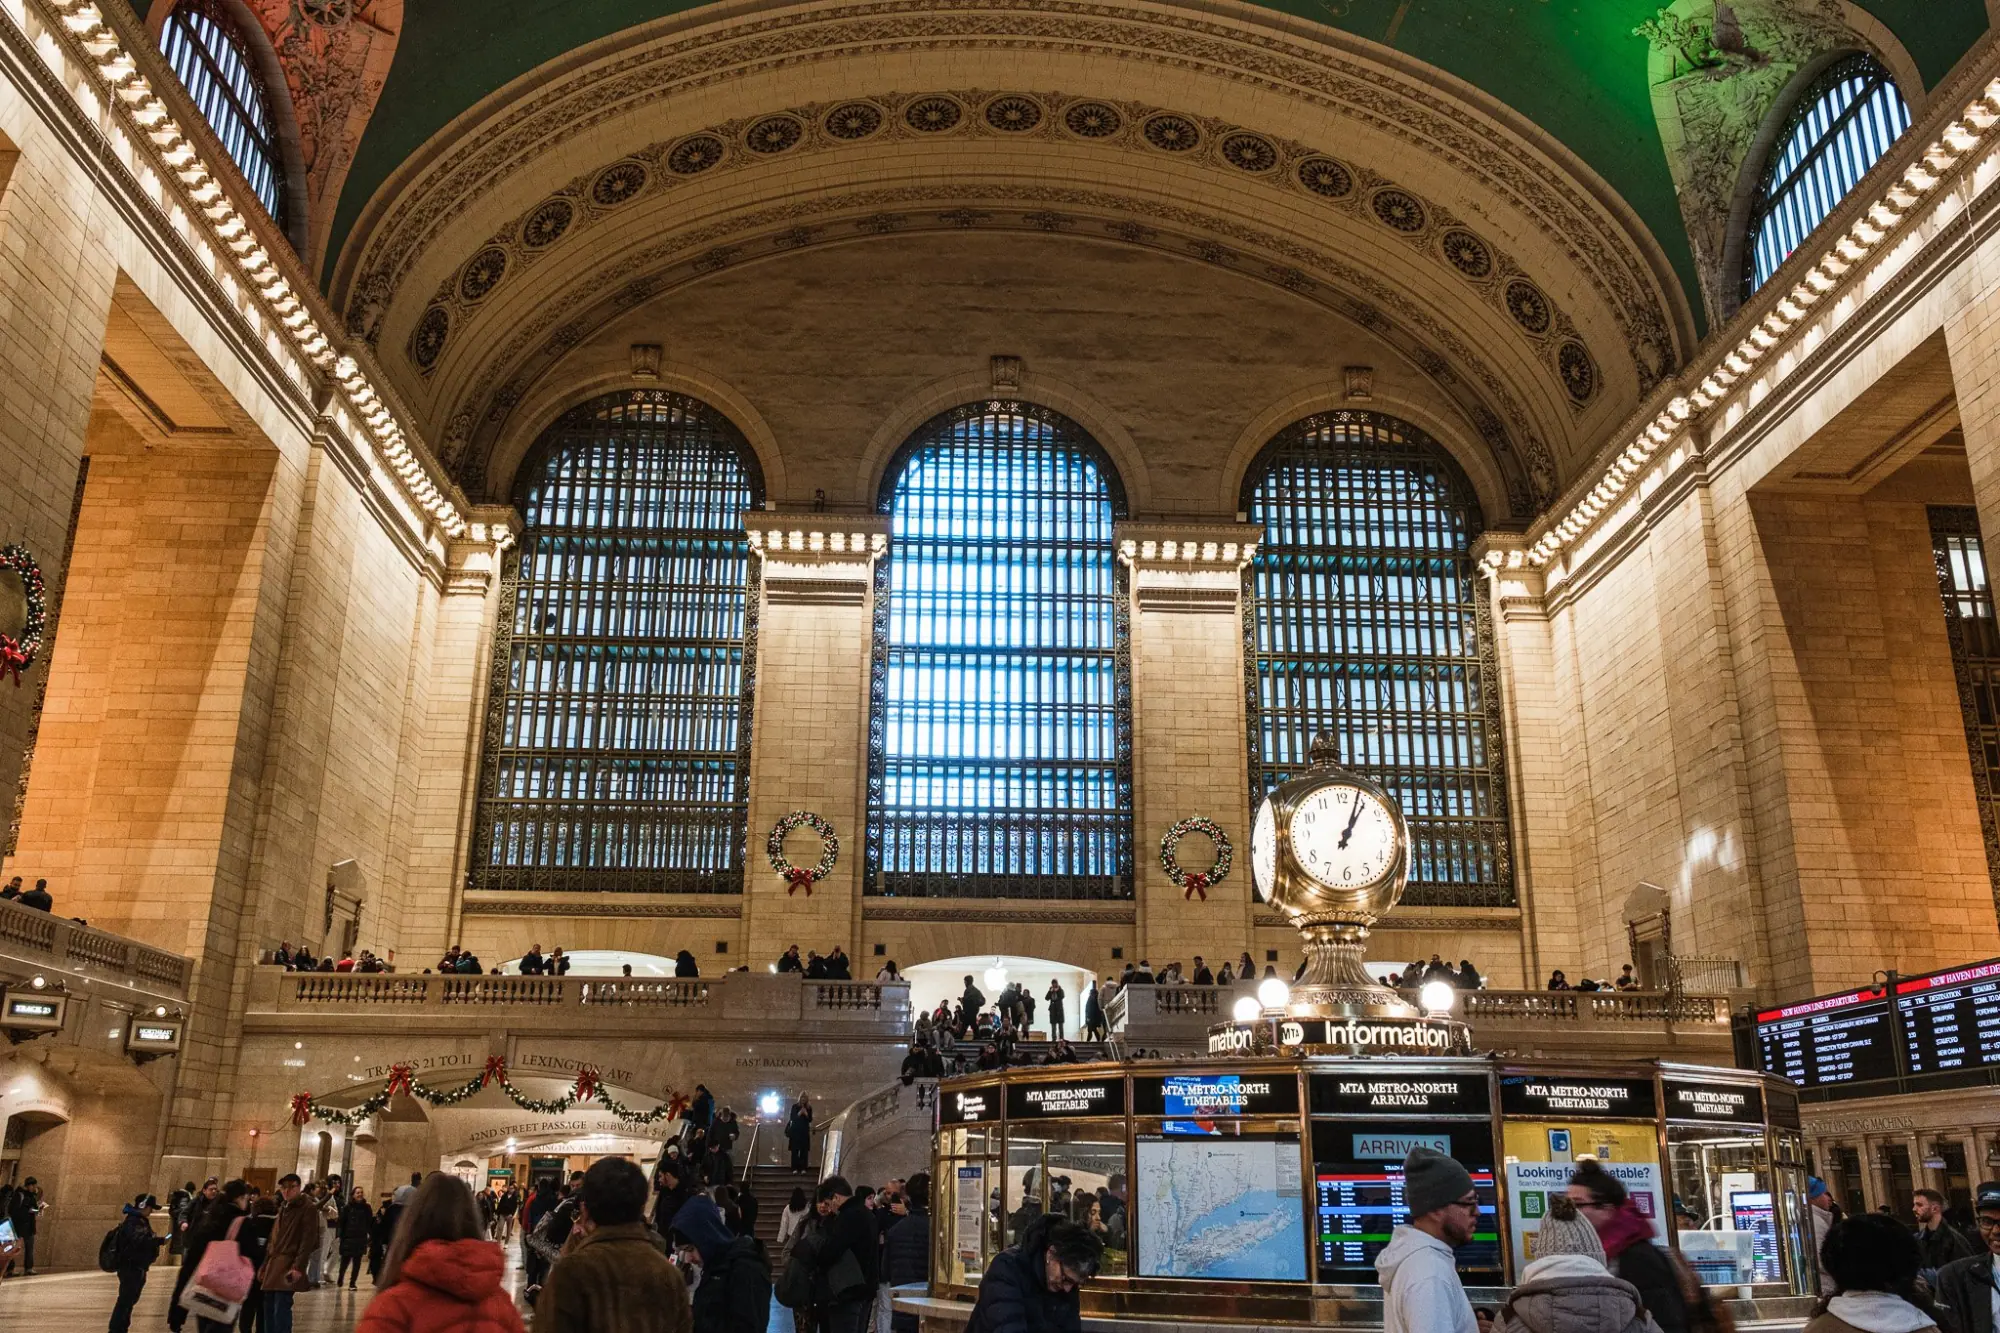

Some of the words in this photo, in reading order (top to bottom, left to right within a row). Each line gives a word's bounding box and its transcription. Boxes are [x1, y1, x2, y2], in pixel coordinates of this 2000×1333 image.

[1319, 798, 1327, 809] 11
[1337, 793, 1348, 803] 12
[1305, 812, 1315, 824] 10
[1309, 849, 1317, 863] 8
[1376, 850, 1383, 862] 4
[1324, 862, 1332, 875] 7
[1343, 866, 1351, 880] 6
[1361, 863, 1369, 876] 5
[1929, 975, 1945, 986] NEW
[1946, 970, 1971, 982] HAVEN
[1972, 967, 1988, 978] LINE
[1781, 1008, 1794, 1017] NEW
[1794, 1005, 1811, 1015] HAVEN
[1825, 994, 1859, 1008] DEPARTURES
[1325, 1020, 1450, 1047] Information
[424, 1058, 435, 1068] 21
[438, 1055, 458, 1066] TO
[735, 1058, 760, 1067] EAST
[763, 1058, 811, 1068] BALCONY
[522, 1054, 605, 1075] LEXINGTON
[606, 1067, 634, 1083] AVE
[1026, 1092, 1043, 1101] MTA
[1045, 1088, 1105, 1100] METRO-NORTH
[1161, 1086, 1185, 1096] MTA
[1187, 1083, 1270, 1095] METRO-NORTH
[1340, 1083, 1365, 1093] MTA
[1368, 1083, 1458, 1093] METRO-NORTH
[1525, 1085, 1549, 1096] MTA
[1550, 1086, 1628, 1098] METRO-NORTH
[1182, 1096, 1248, 1106] TIMETABLES
[1370, 1095, 1428, 1105] ARRIVALS
[1547, 1097, 1610, 1109] TIMETABLES
[1678, 1091, 1694, 1102] MTA
[1696, 1091, 1744, 1105] METRO-NORTH
[1042, 1100, 1089, 1111] TIMETABLES
[1693, 1102, 1733, 1114] TIMETABLES
[1833, 1119, 1870, 1133] VENDING
[1870, 1116, 1913, 1131] MACHINES
[469, 1129, 497, 1142] 42ND
[499, 1123, 538, 1136] STREET
[541, 1121, 587, 1131] PASSAGE
[596, 1122, 641, 1133] SUBWAY
[1517, 1166, 1562, 1180] Looking
